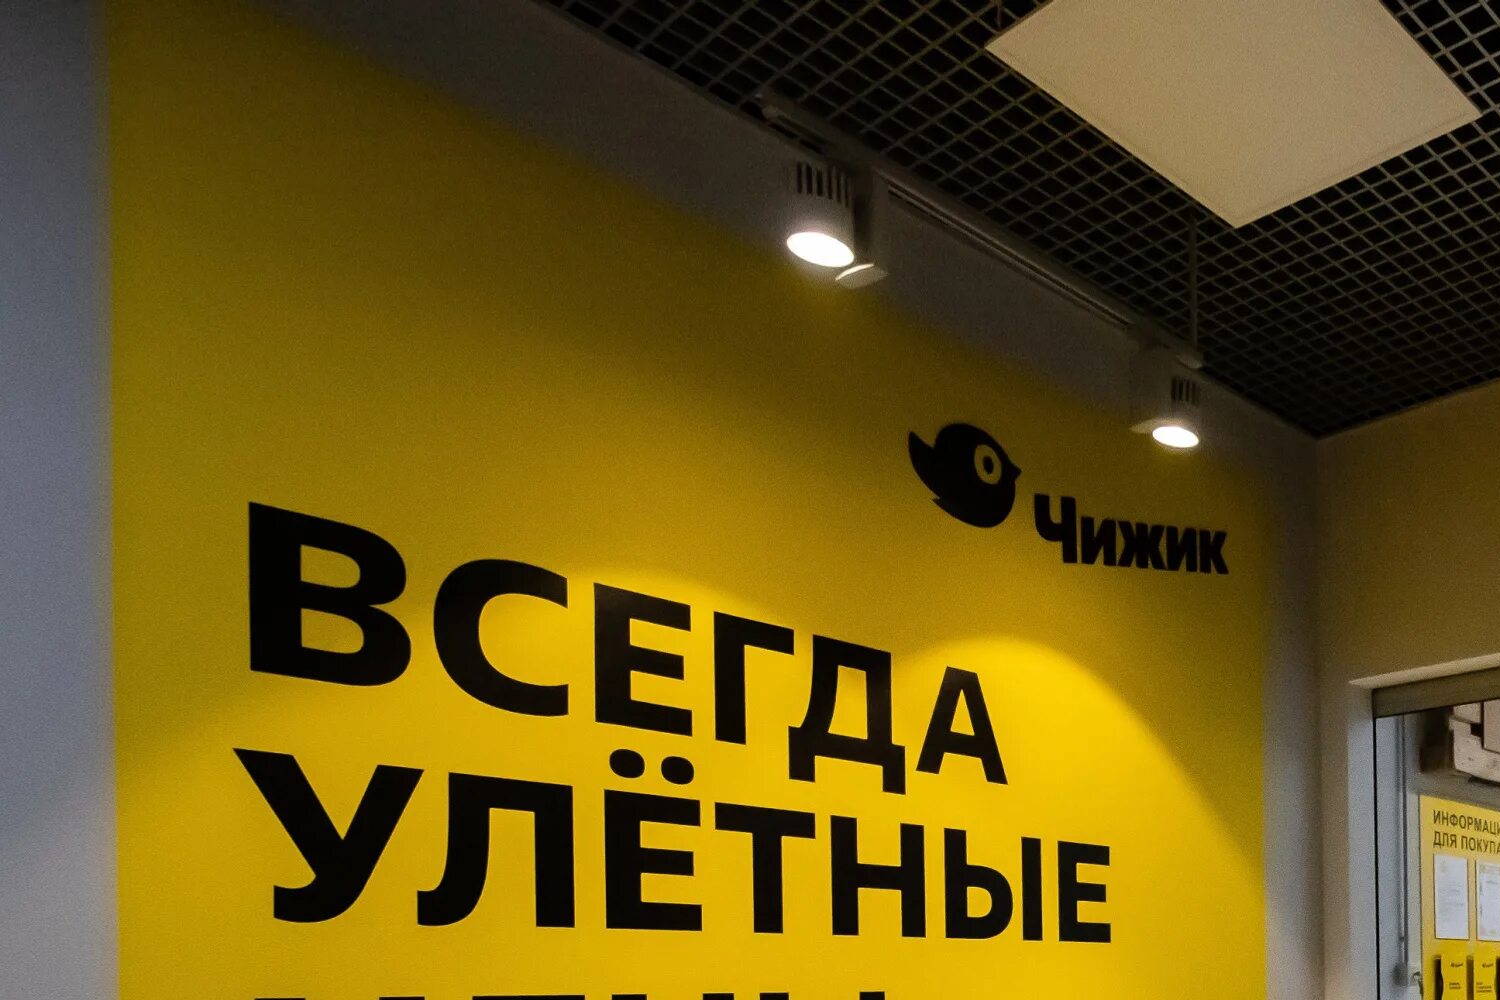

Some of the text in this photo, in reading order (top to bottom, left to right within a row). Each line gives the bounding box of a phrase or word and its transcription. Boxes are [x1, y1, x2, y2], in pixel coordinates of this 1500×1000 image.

[1034, 493, 1229, 575] Чижик
[248, 502, 1007, 795] ВСЕГДА
[233, 748, 1111, 943] УЛЁТНЫЕ
[1432, 830, 1457, 848] ДЛЯ
